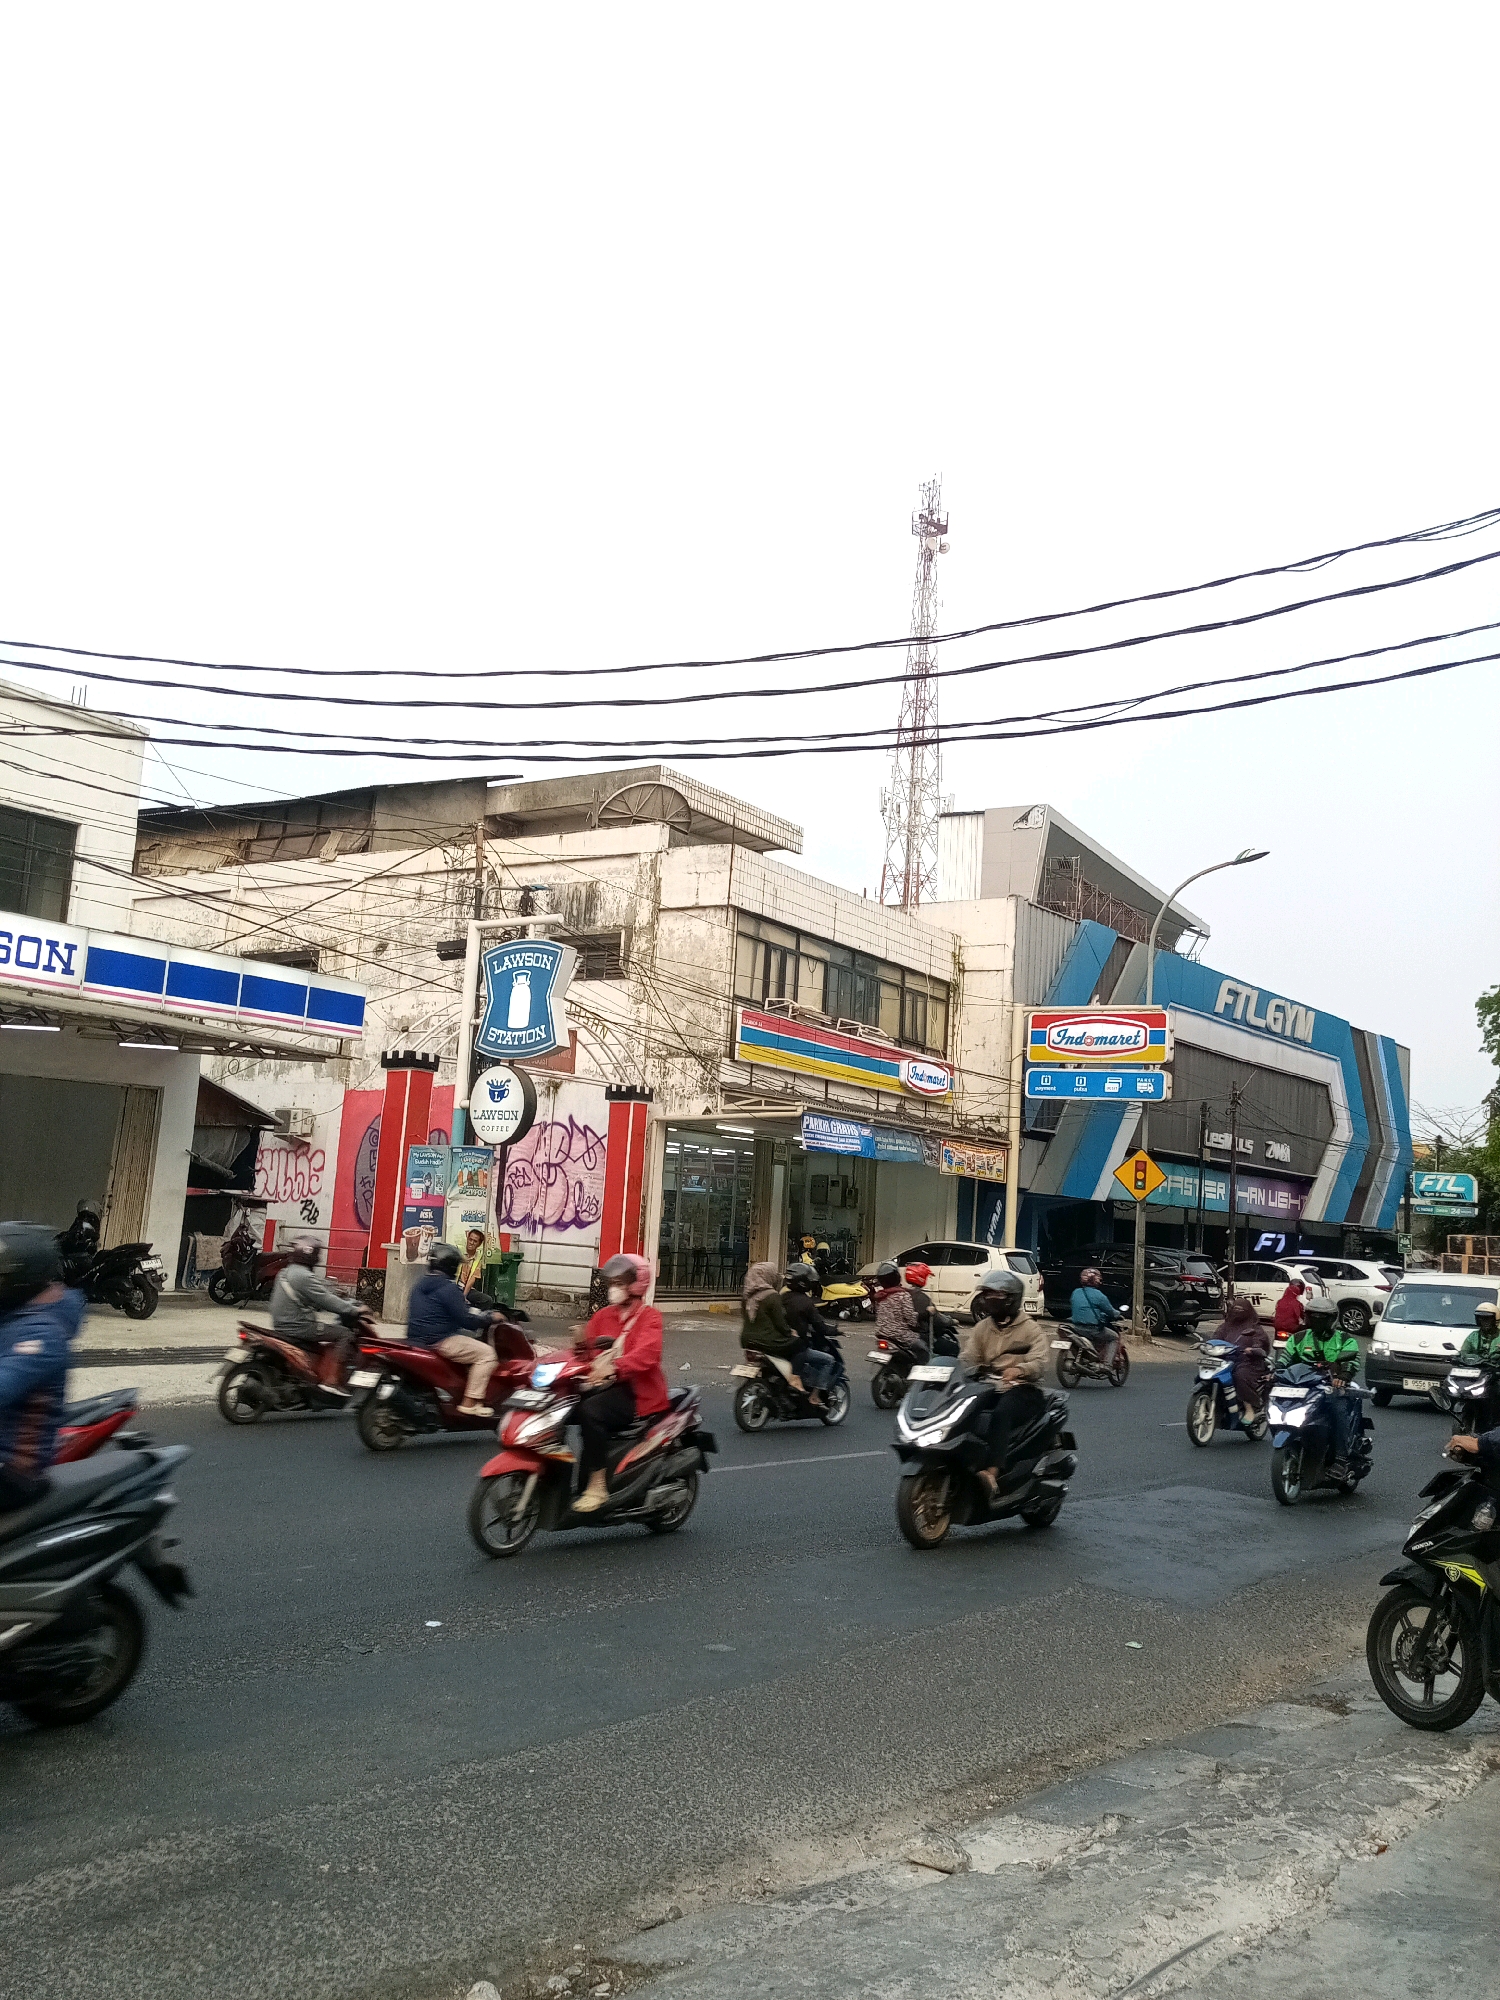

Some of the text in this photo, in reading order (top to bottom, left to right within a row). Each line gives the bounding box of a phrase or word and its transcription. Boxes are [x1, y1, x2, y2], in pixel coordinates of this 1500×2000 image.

[492, 952, 553, 975] LAWSON
[486, 1024, 547, 1046] STATION
[473, 1109, 520, 1121] LAWSON
[480, 1125, 510, 1133] COFFEE
[1419, 1174, 1466, 1192] FTL
